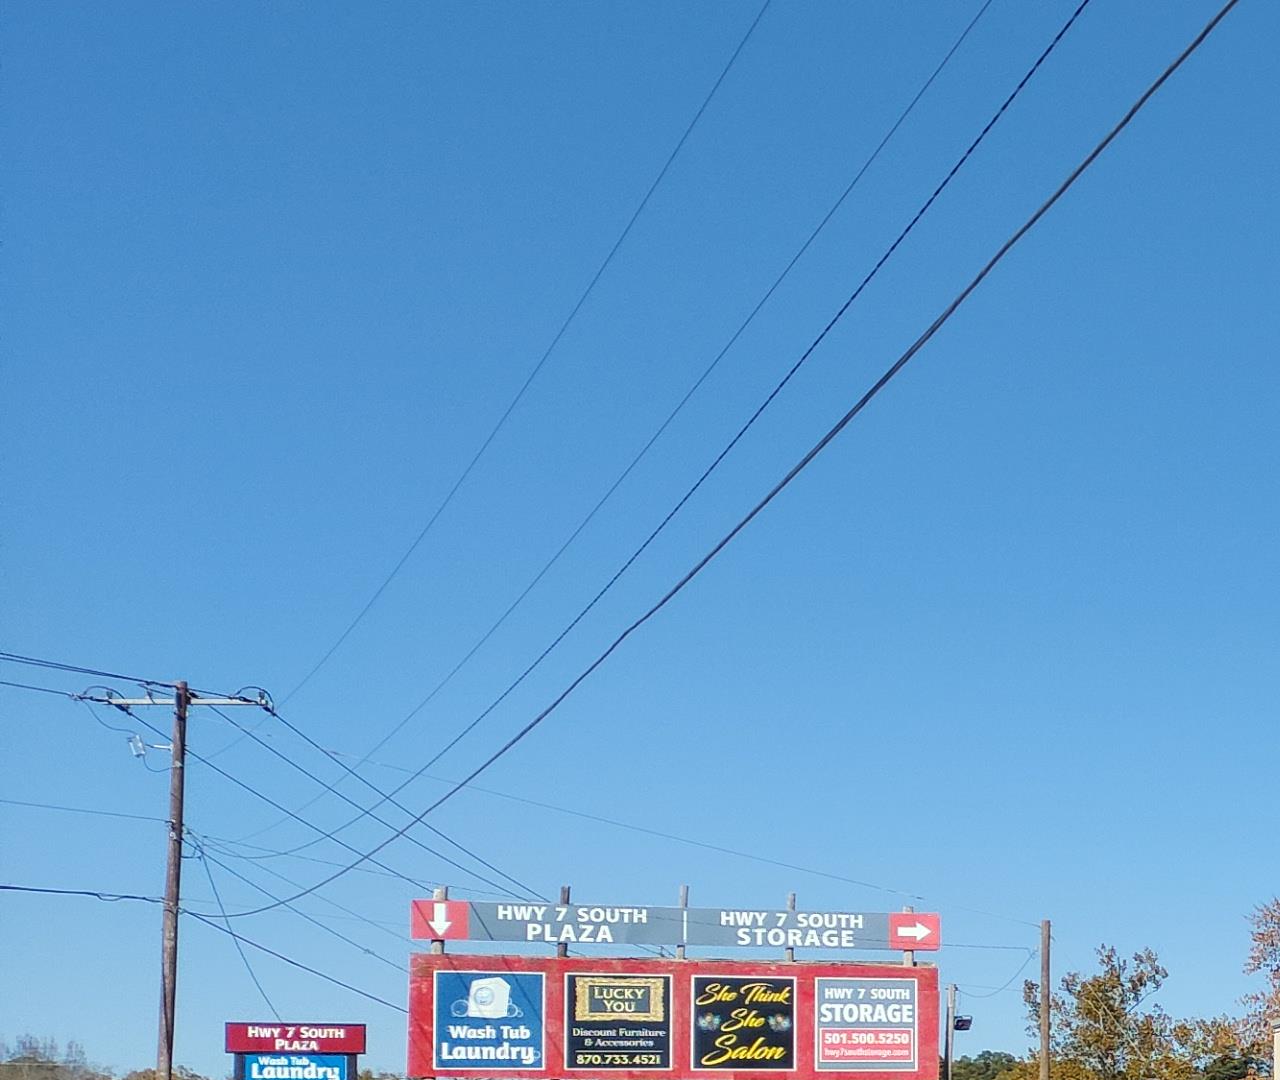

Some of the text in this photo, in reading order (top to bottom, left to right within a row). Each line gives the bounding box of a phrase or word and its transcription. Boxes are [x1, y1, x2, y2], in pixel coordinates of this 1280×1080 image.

[497, 905, 648, 924] HWY 7 SOUTH
[720, 911, 864, 929] HWY 7 SOUTH
[527, 924, 613, 943] PLAZA
[737, 928, 855, 947] STORAGE
[594, 987, 645, 999] LUCKY
[696, 983, 792, 1005] She Think
[825, 988, 910, 1000] HWY 7 SOUTH
[604, 1000, 635, 1012] YOU
[820, 1003, 913, 1023] STORAGE
[721, 1008, 766, 1032] She
[247, 1026, 345, 1038] HWY 7 SOUTH
[448, 1025, 531, 1039] Wash Tub
[573, 1028, 666, 1037] Discount Furniture
[825, 1033, 909, 1044] 501.500.5250
[275, 1039, 319, 1051] PLAZA
[595, 1038, 654, 1046] Accessories
[441, 1042, 534, 1064] Laundry
[701, 1033, 786, 1065] Salon
[258, 1057, 310, 1066] Wash Tub
[576, 1054, 661, 1065] 870.733.4521
